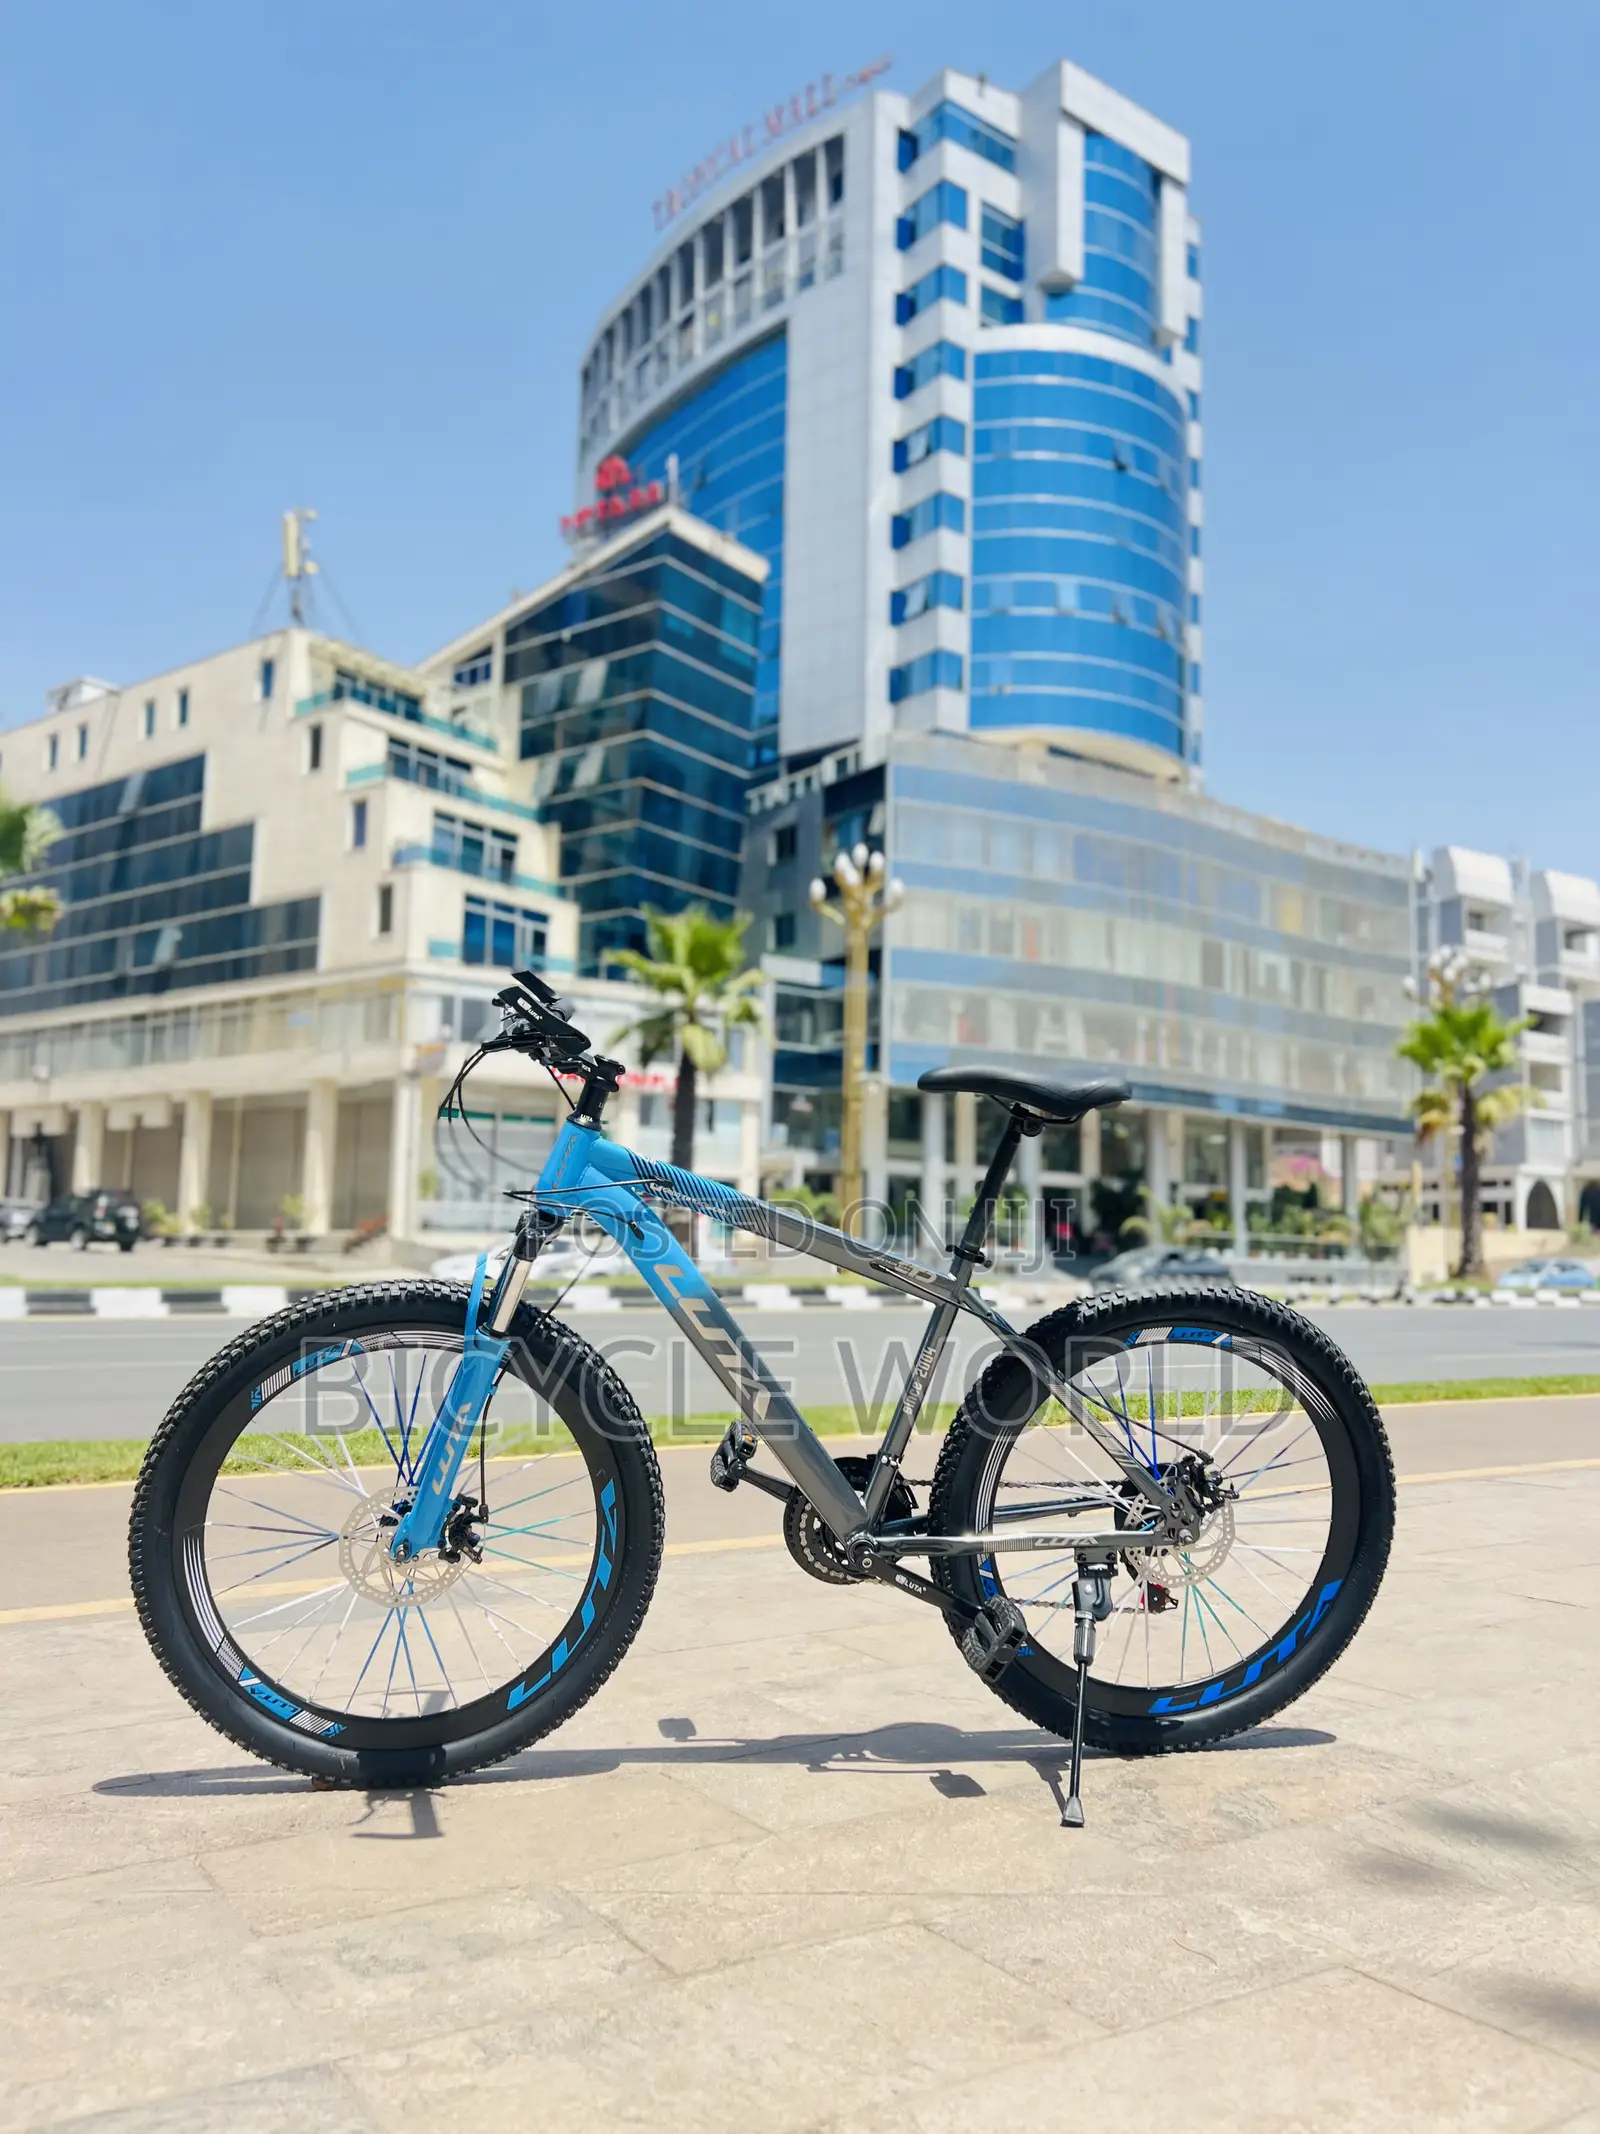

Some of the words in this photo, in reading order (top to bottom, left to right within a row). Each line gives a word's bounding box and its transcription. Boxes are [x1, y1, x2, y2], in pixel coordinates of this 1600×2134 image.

[580, 1113, 594, 1123] LUTA
[653, 1263, 772, 1421] LUTA
[1034, 1535, 1100, 1547] LUTA
